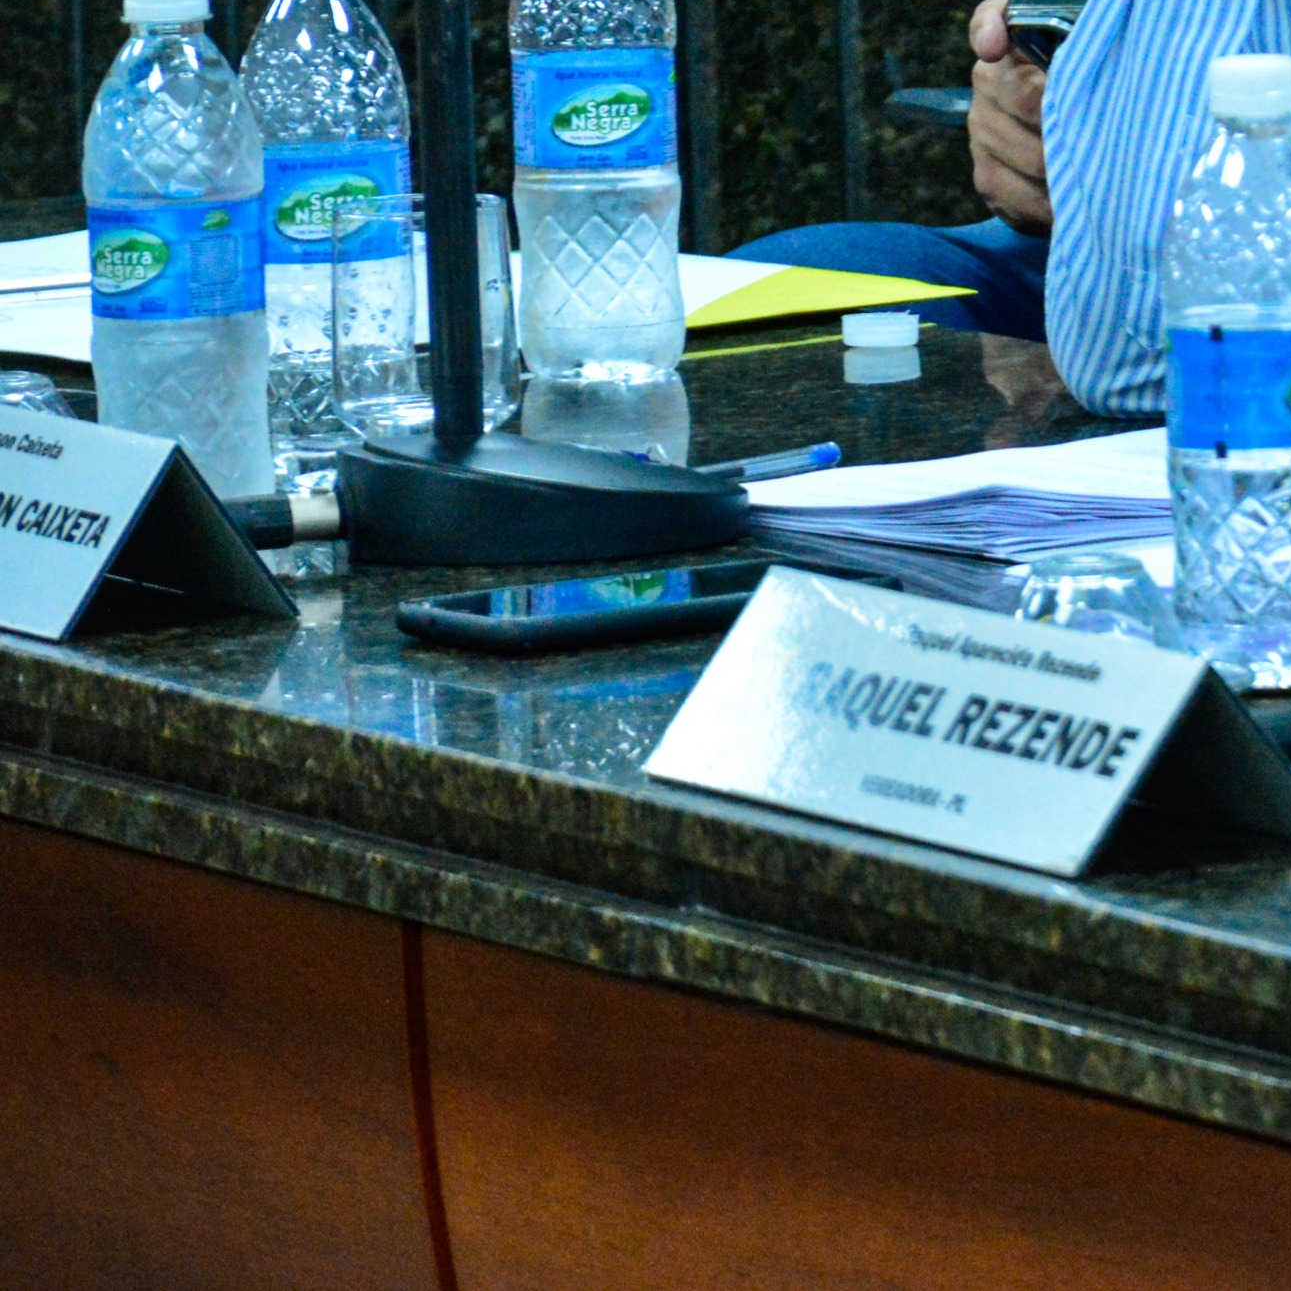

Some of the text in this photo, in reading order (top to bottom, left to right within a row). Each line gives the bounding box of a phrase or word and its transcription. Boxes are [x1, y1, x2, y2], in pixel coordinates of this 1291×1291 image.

[585, 101, 639, 118] Serra
[570, 114, 633, 134] Negra
[310, 193, 366, 210] Serr
[103, 245, 152, 265] Serra
[95, 261, 146, 283] Negra
[17, 434, 64, 460] Caixeta
[16, 499, 111, 548] CAIXETA
[943, 692, 1141, 779] REZENDE
